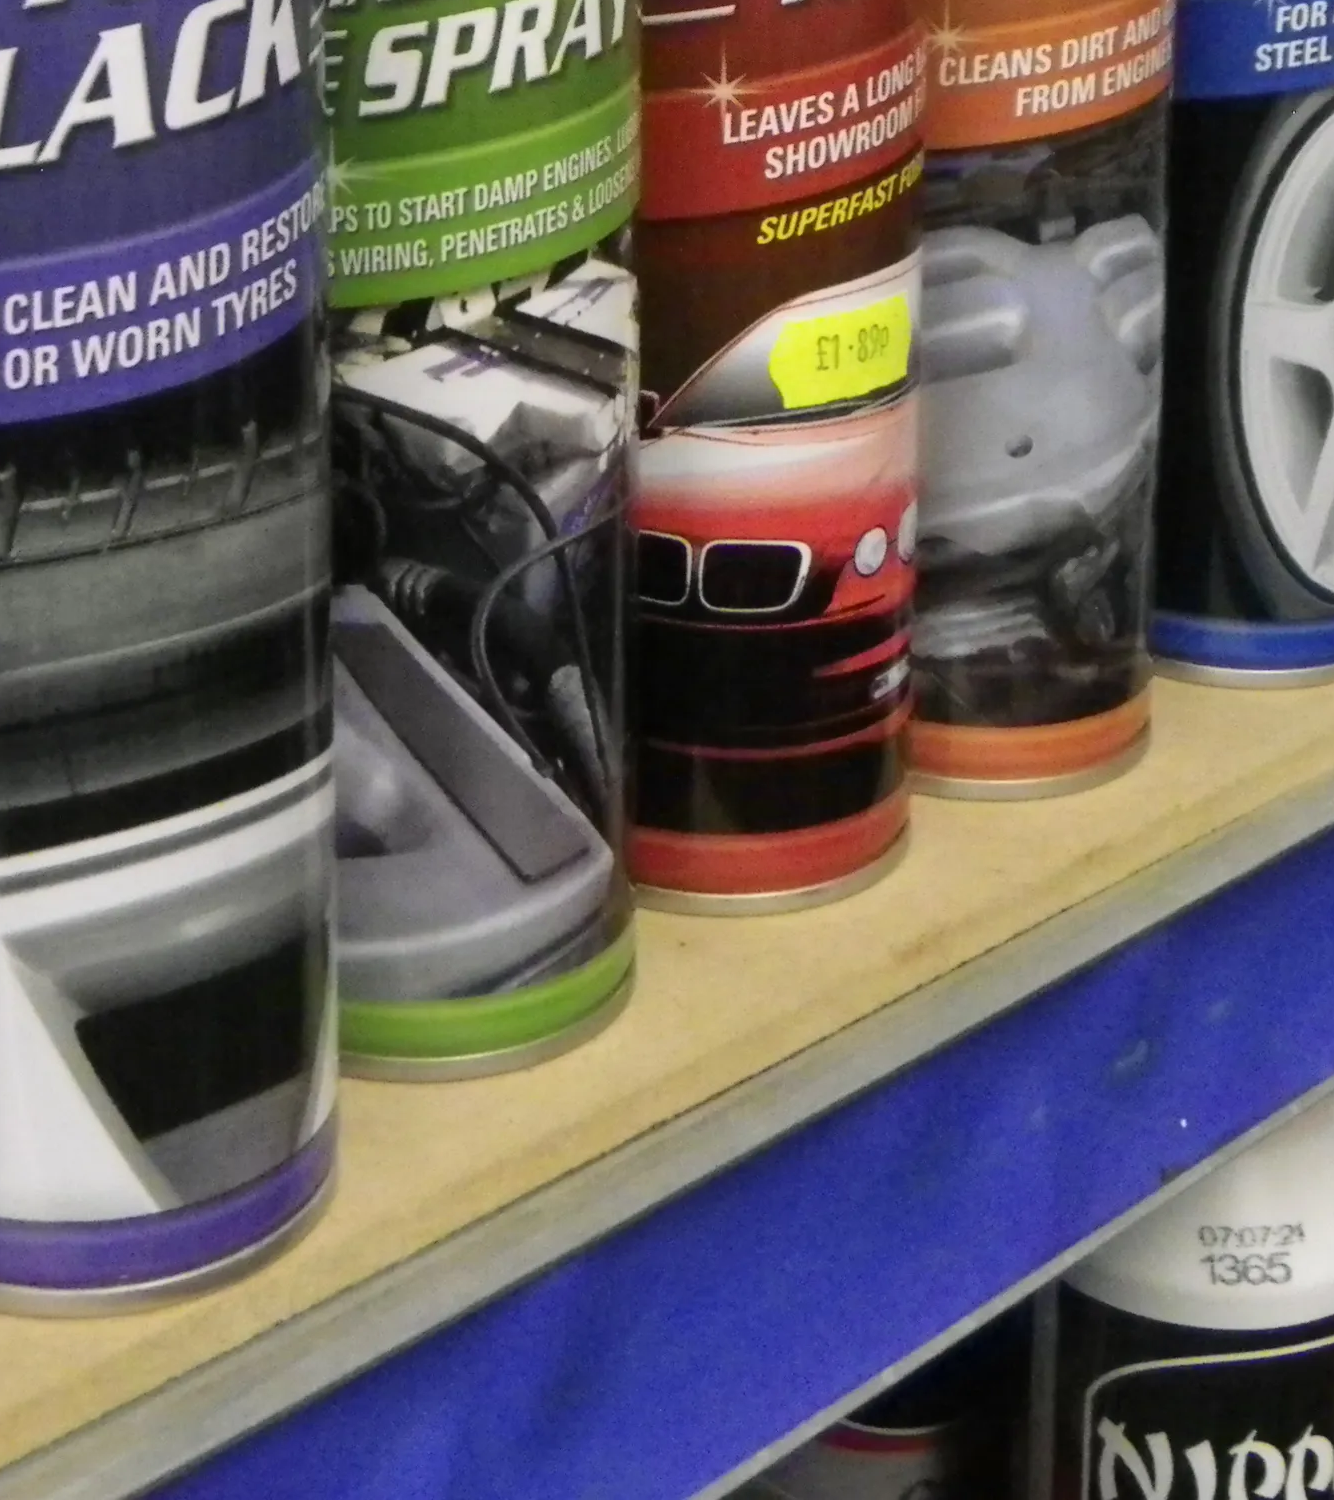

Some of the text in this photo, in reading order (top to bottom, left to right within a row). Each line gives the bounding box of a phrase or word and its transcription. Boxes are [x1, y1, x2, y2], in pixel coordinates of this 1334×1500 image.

[938, 42, 1053, 88] CLEANS
[1060, 25, 1119, 71] DIRT
[1122, 6, 1162, 46] AND
[1253, 35, 1334, 74] STEEL
[1275, 0, 1328, 35] FOR
[722, 90, 835, 145] LEAVES
[840, 82, 861, 118] A
[866, 53, 914, 108] LONG
[1015, 72, 1097, 118] FROM
[764, 95, 914, 180] SHOWROOM
[340, 238, 435, 277] WIRING,
[440, 201, 569, 263] PENETRATES
[571, 193, 587, 222] &
[366, 201, 393, 230] TO
[398, 187, 470, 227] START
[474, 170, 539, 213] DAMP
[756, 173, 899, 245] SUPERFAST
[4, 270, 137, 335] CLEAN
[148, 242, 231, 304] AND
[4, 344, 60, 392] OR
[71, 315, 201, 380] WORN
[210, 258, 298, 334] TYRES
[1198, 1250, 1294, 1286] 1365
